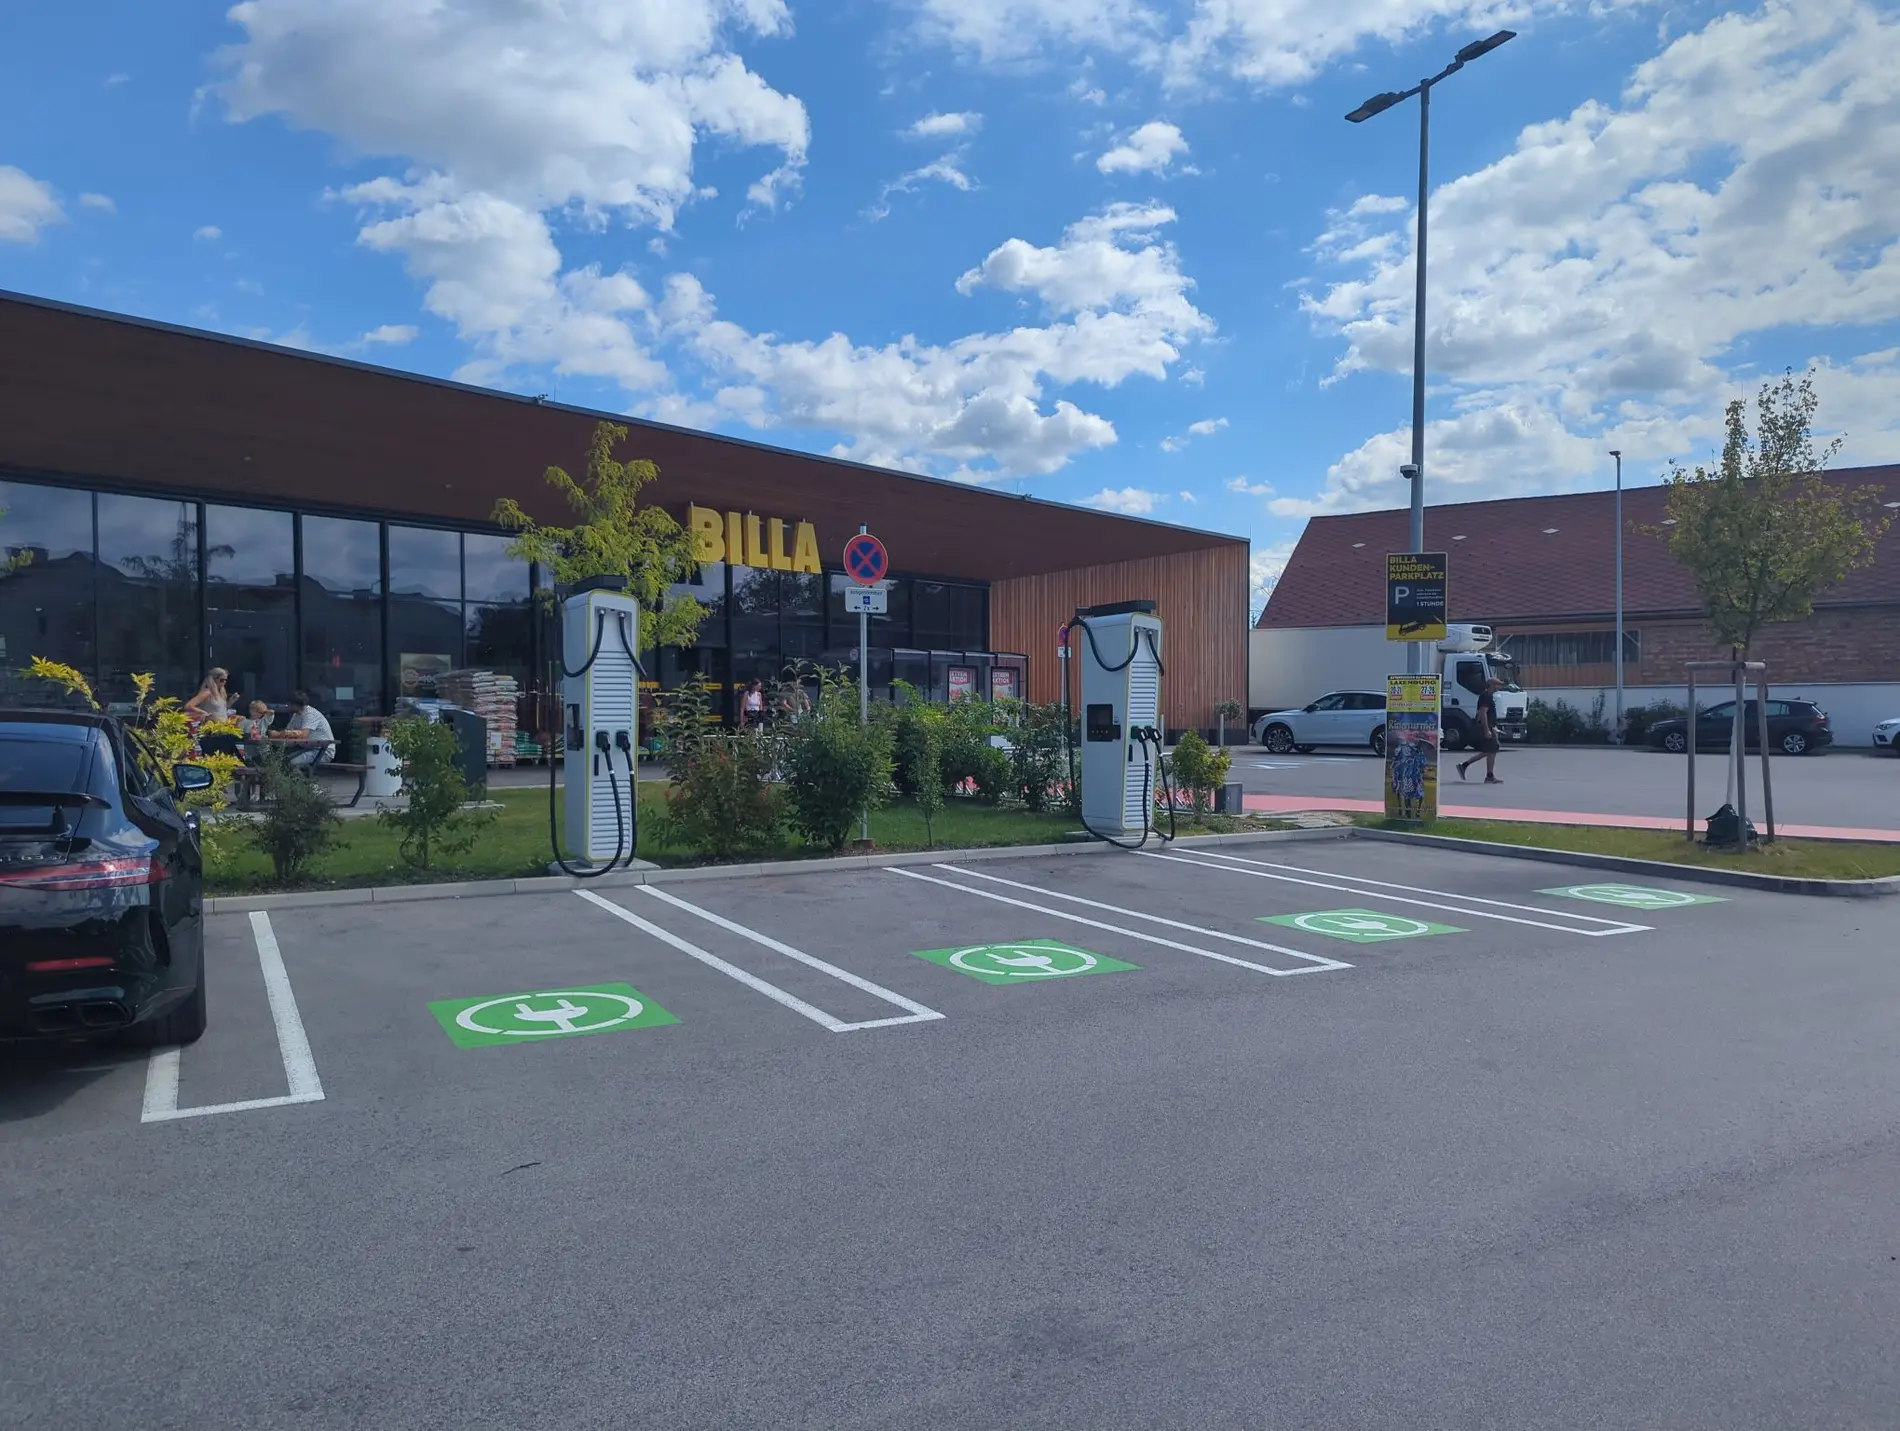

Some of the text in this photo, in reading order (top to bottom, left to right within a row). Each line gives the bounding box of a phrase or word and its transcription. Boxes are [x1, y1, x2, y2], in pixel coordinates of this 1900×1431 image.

[688, 506, 822, 574] BILLA
[1389, 556, 1417, 564] BILLA
[1389, 564, 1435, 572] KUNDEN-
[1389, 571, 1445, 580] PARKPLATZ
[1395, 586, 1410, 605] P
